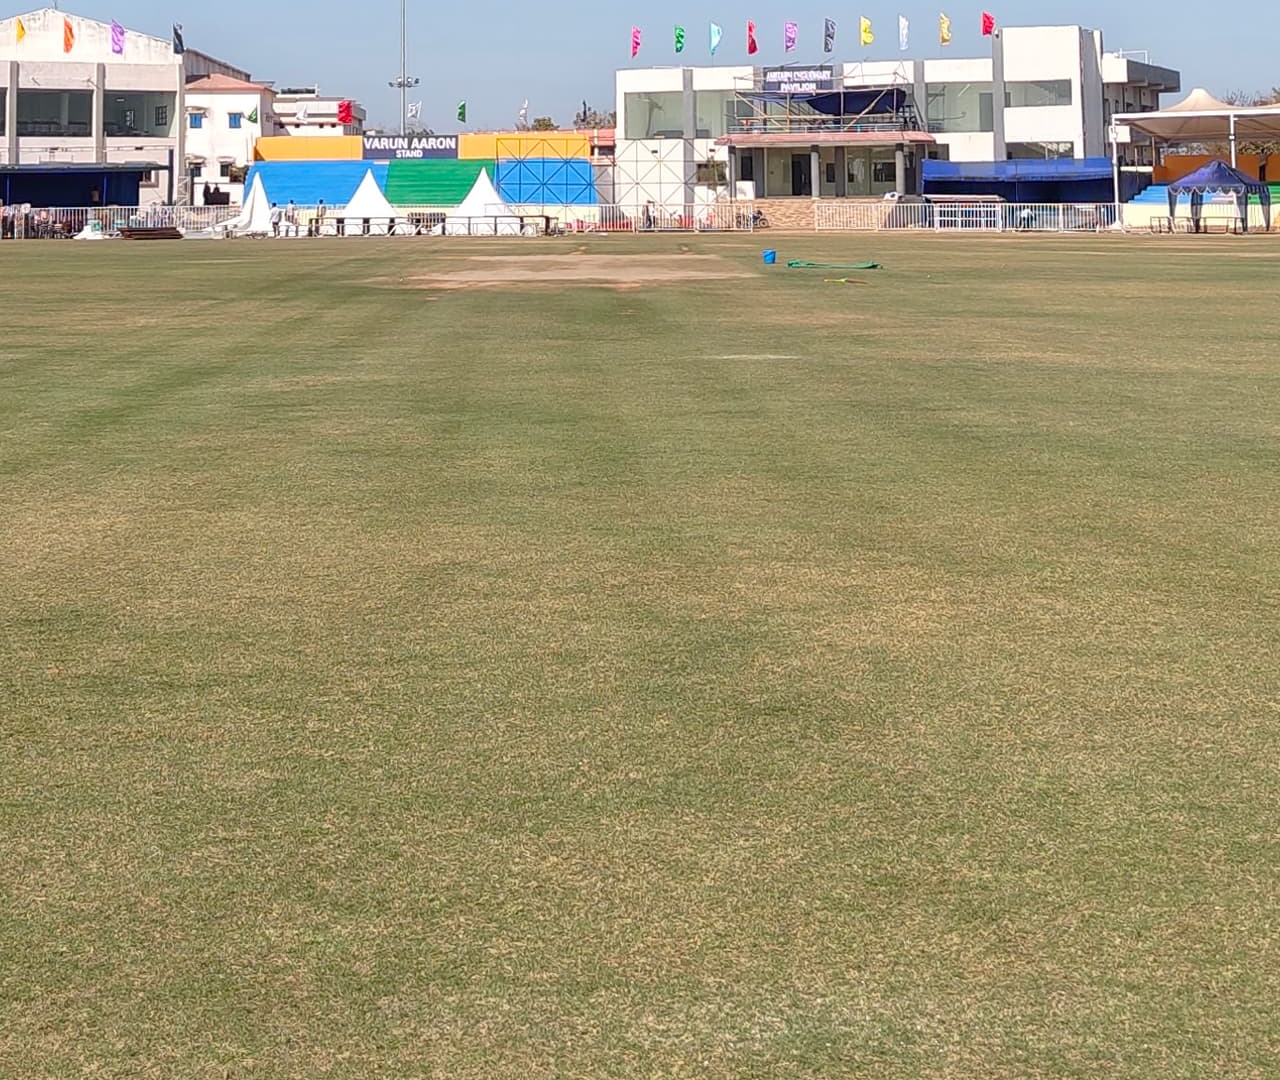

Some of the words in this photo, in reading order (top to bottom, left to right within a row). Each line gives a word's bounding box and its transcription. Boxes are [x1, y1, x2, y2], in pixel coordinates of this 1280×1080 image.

[364, 137, 408, 149] VARUN
[411, 137, 456, 149] AARON
[396, 149, 423, 158] STAND
